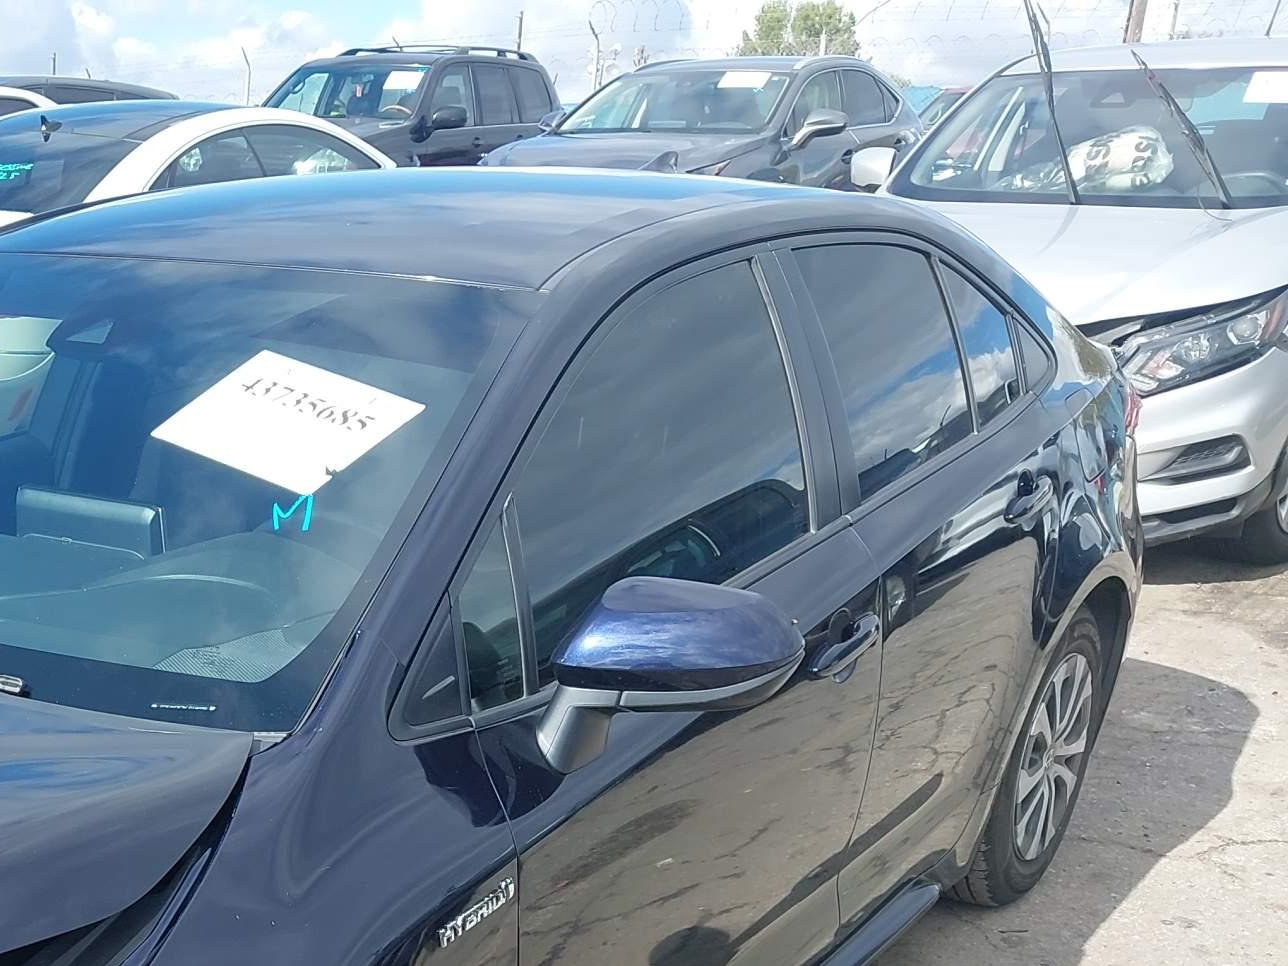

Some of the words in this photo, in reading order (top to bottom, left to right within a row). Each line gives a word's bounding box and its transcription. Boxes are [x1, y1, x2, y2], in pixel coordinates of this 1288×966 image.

[241, 377, 377, 431] 43735685
[270, 493, 314, 533] M
[436, 876, 516, 949] HYBRID
